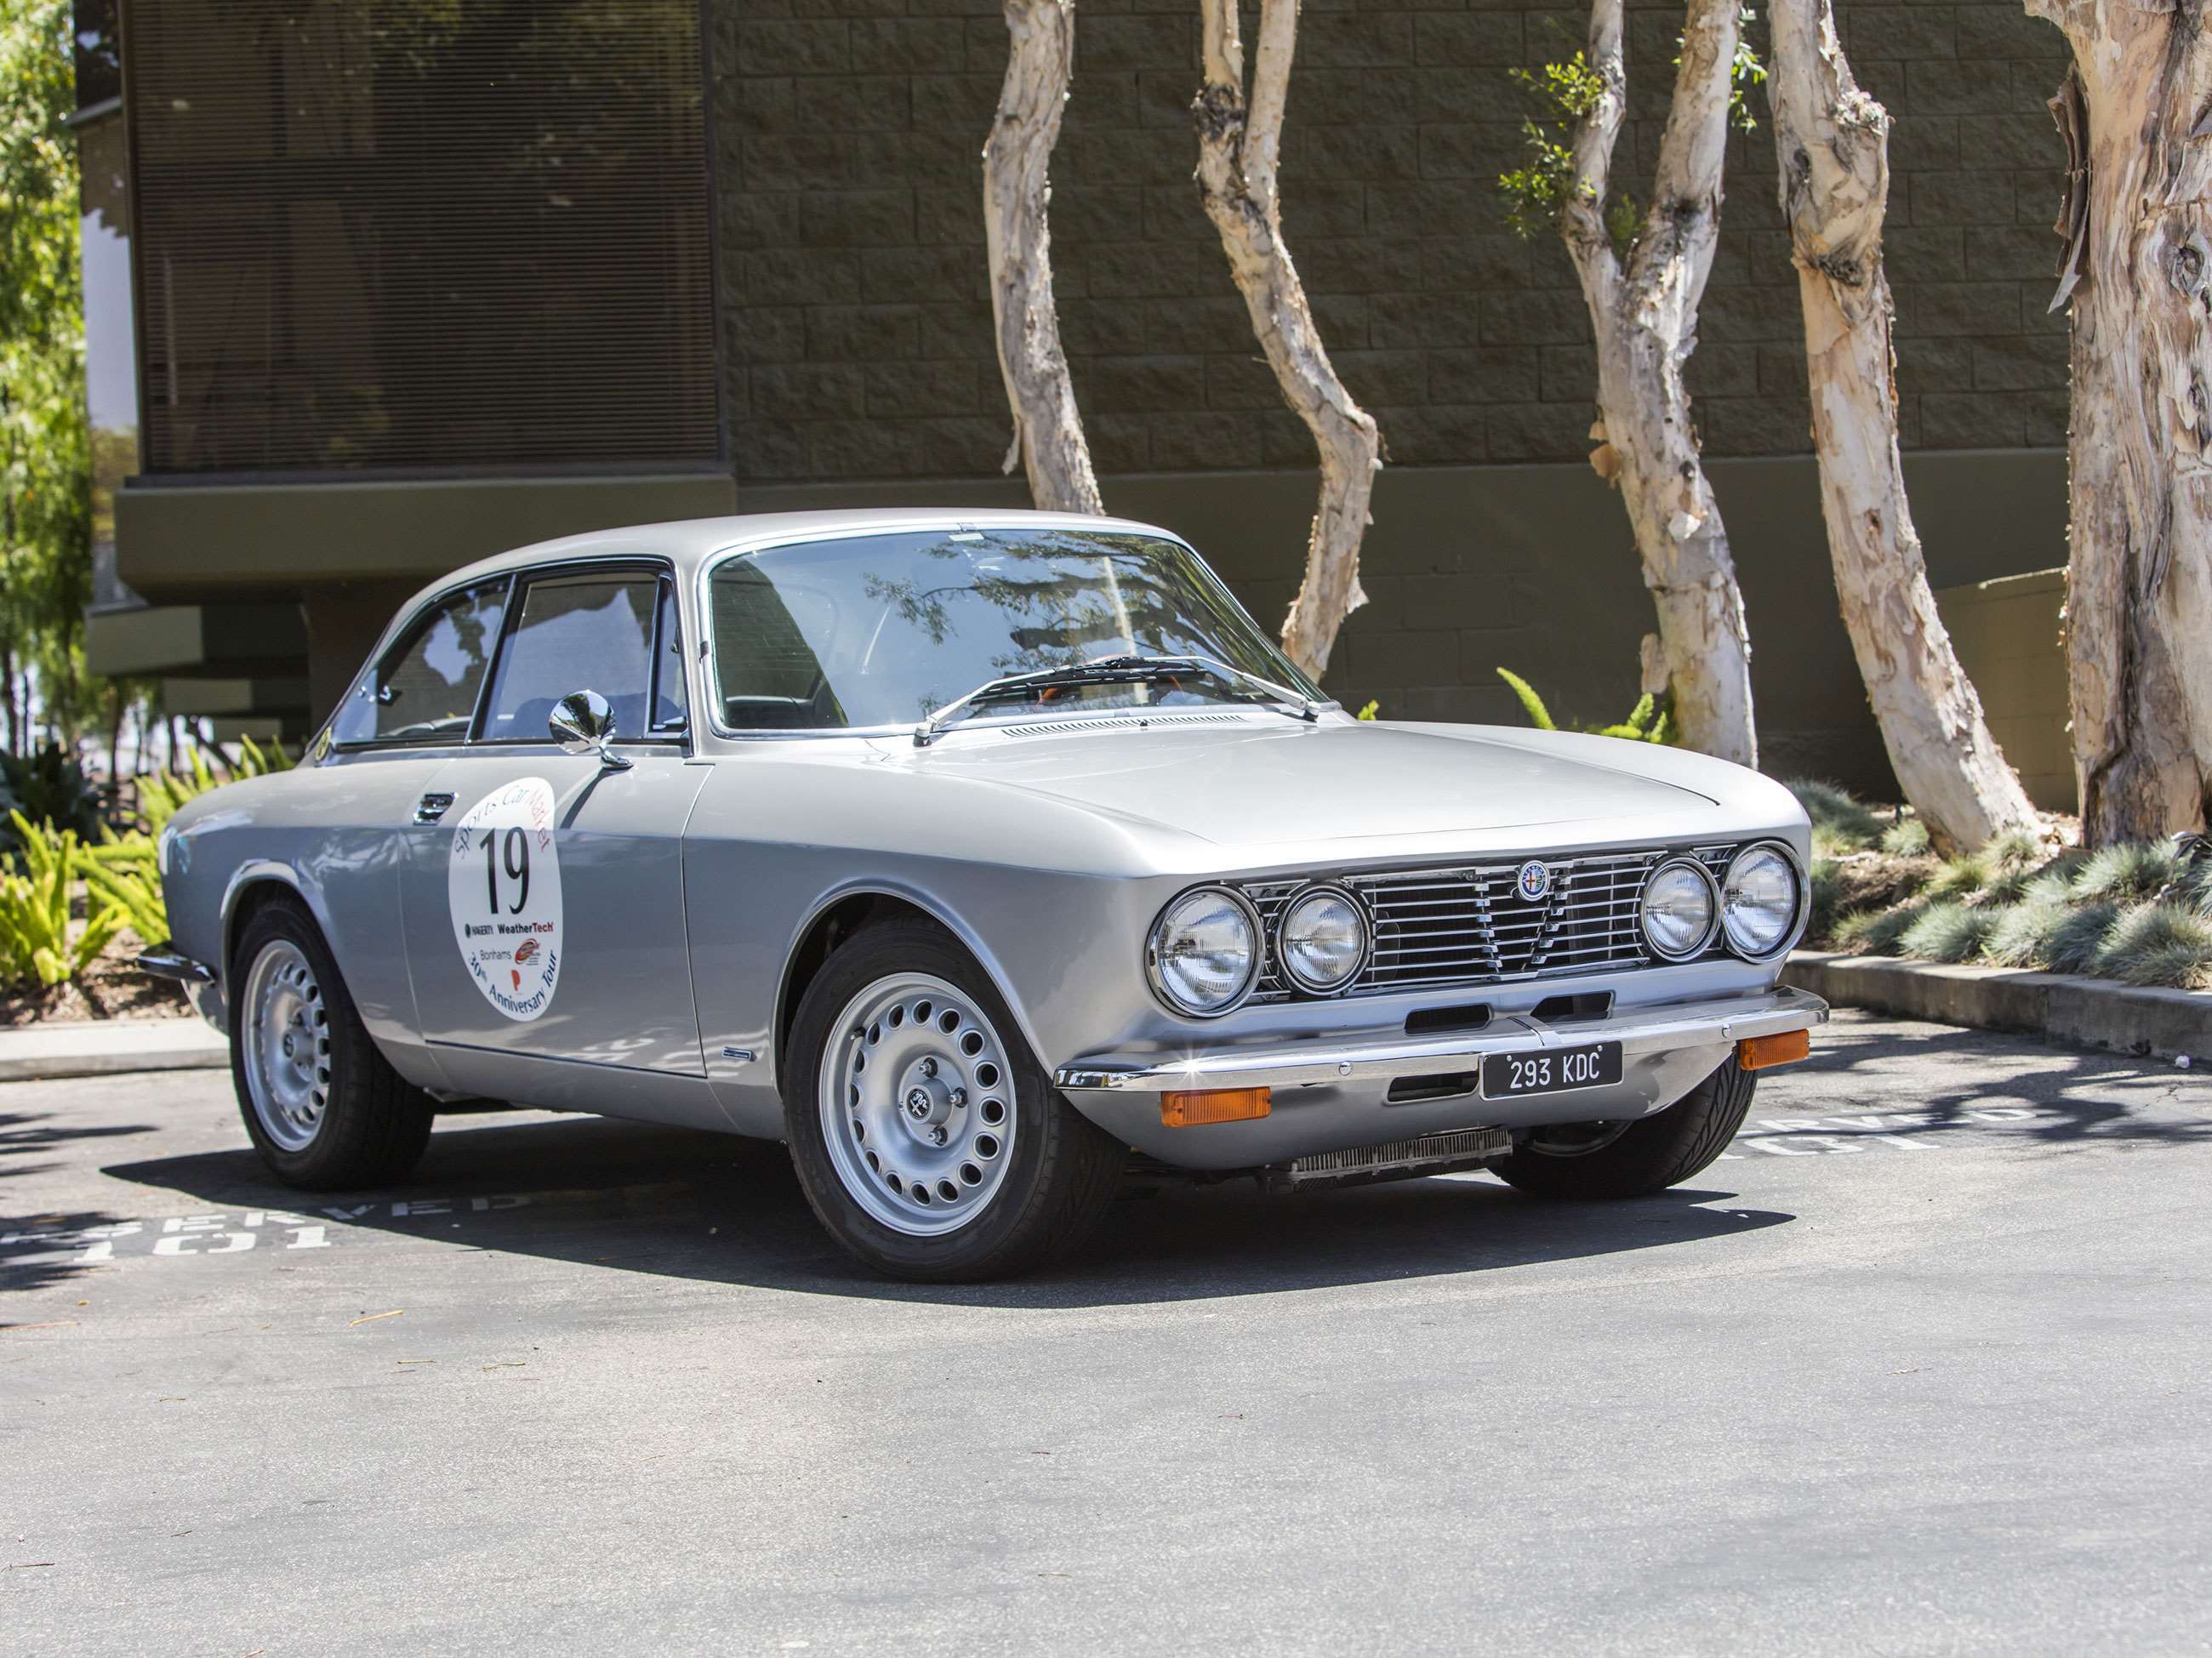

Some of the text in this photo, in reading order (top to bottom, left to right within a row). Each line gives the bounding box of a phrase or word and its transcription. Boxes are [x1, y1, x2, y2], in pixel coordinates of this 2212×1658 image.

[454, 801, 499, 859] Sports
[503, 784, 529, 805] Car
[480, 827, 529, 914] 19
[497, 921, 554, 935] WeatherTech
[480, 949, 512, 960] Bonhams
[489, 984, 548, 1013] Anniversary
[542, 949, 557, 988] Tour
[1510, 1051, 1599, 1089] 293 KDC
